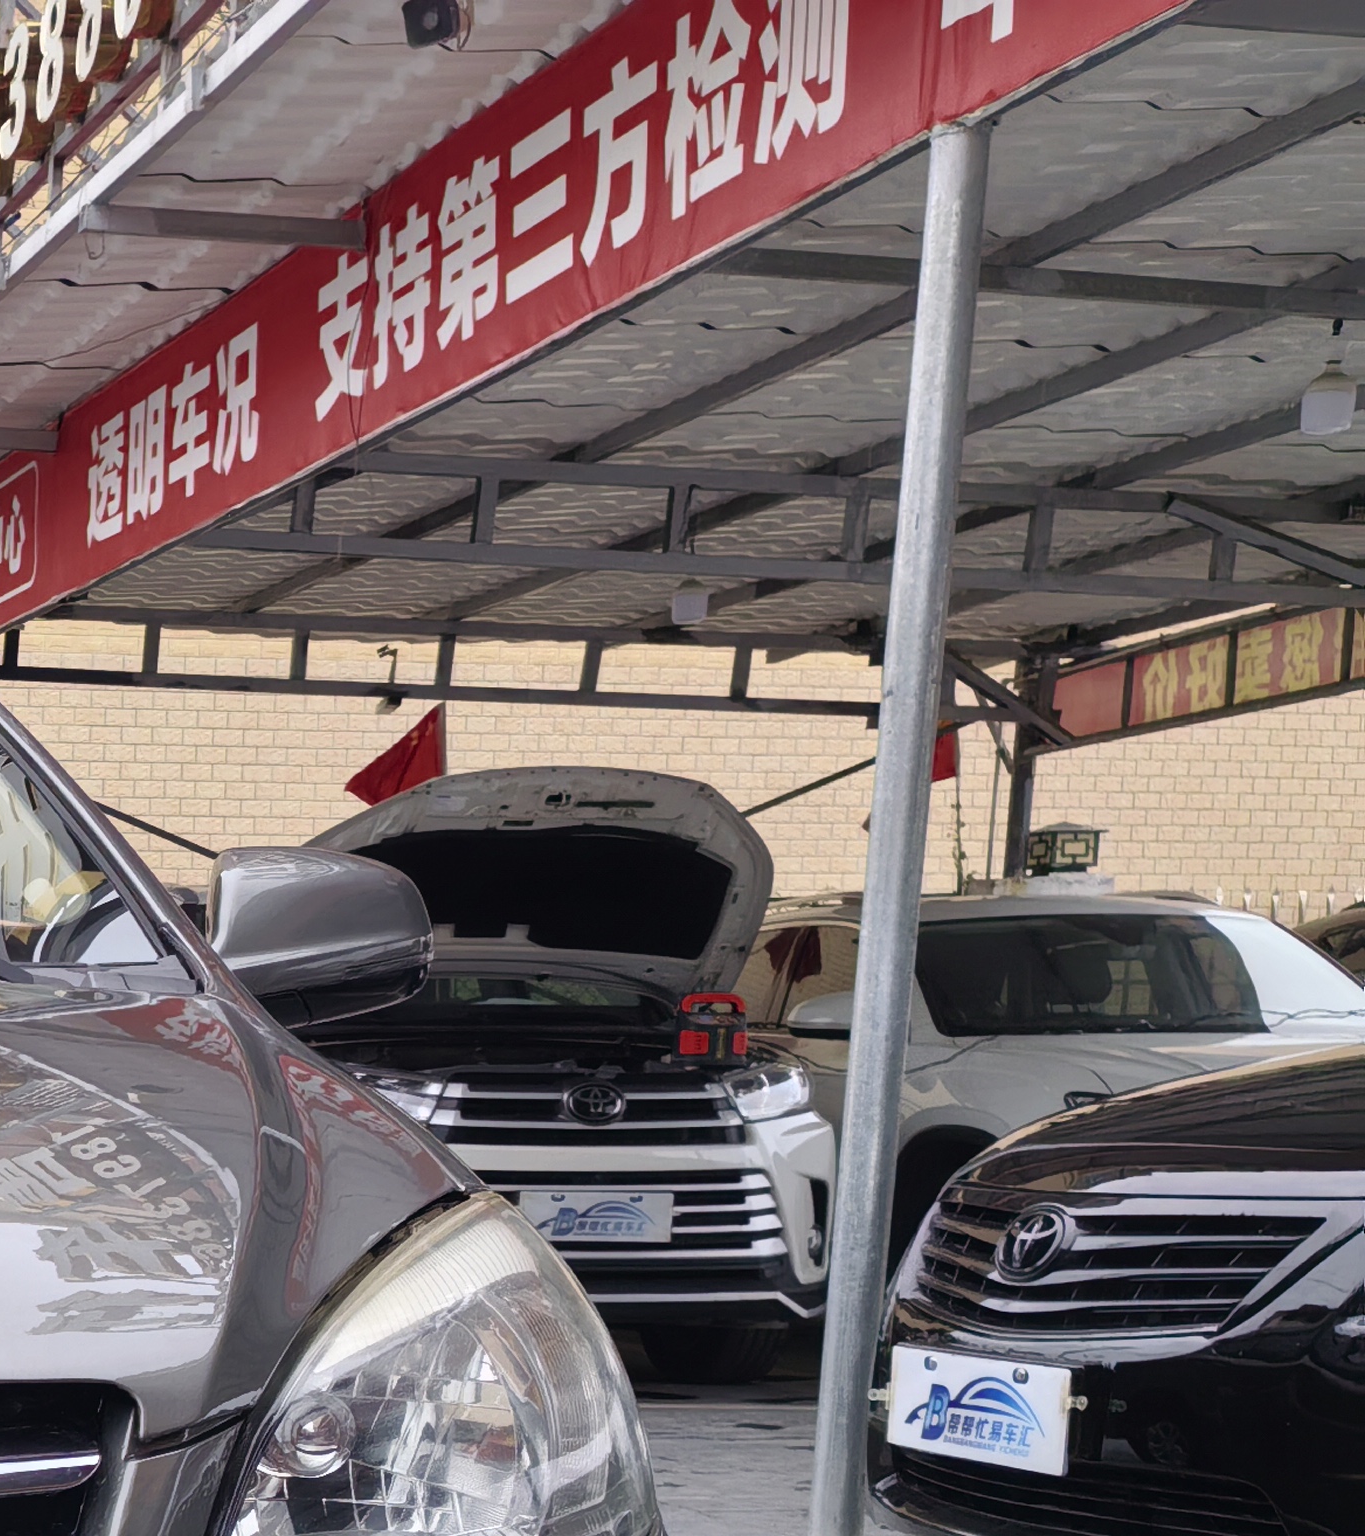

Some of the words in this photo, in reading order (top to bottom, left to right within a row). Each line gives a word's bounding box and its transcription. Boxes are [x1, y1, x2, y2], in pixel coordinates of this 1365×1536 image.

[86, 321, 260, 549] 透明车况
[314, 0, 850, 422] 支持第三方检测
[920, 1383, 950, 1441] B
[947, 1412, 1036, 1448] 帮帮忙易车汇
